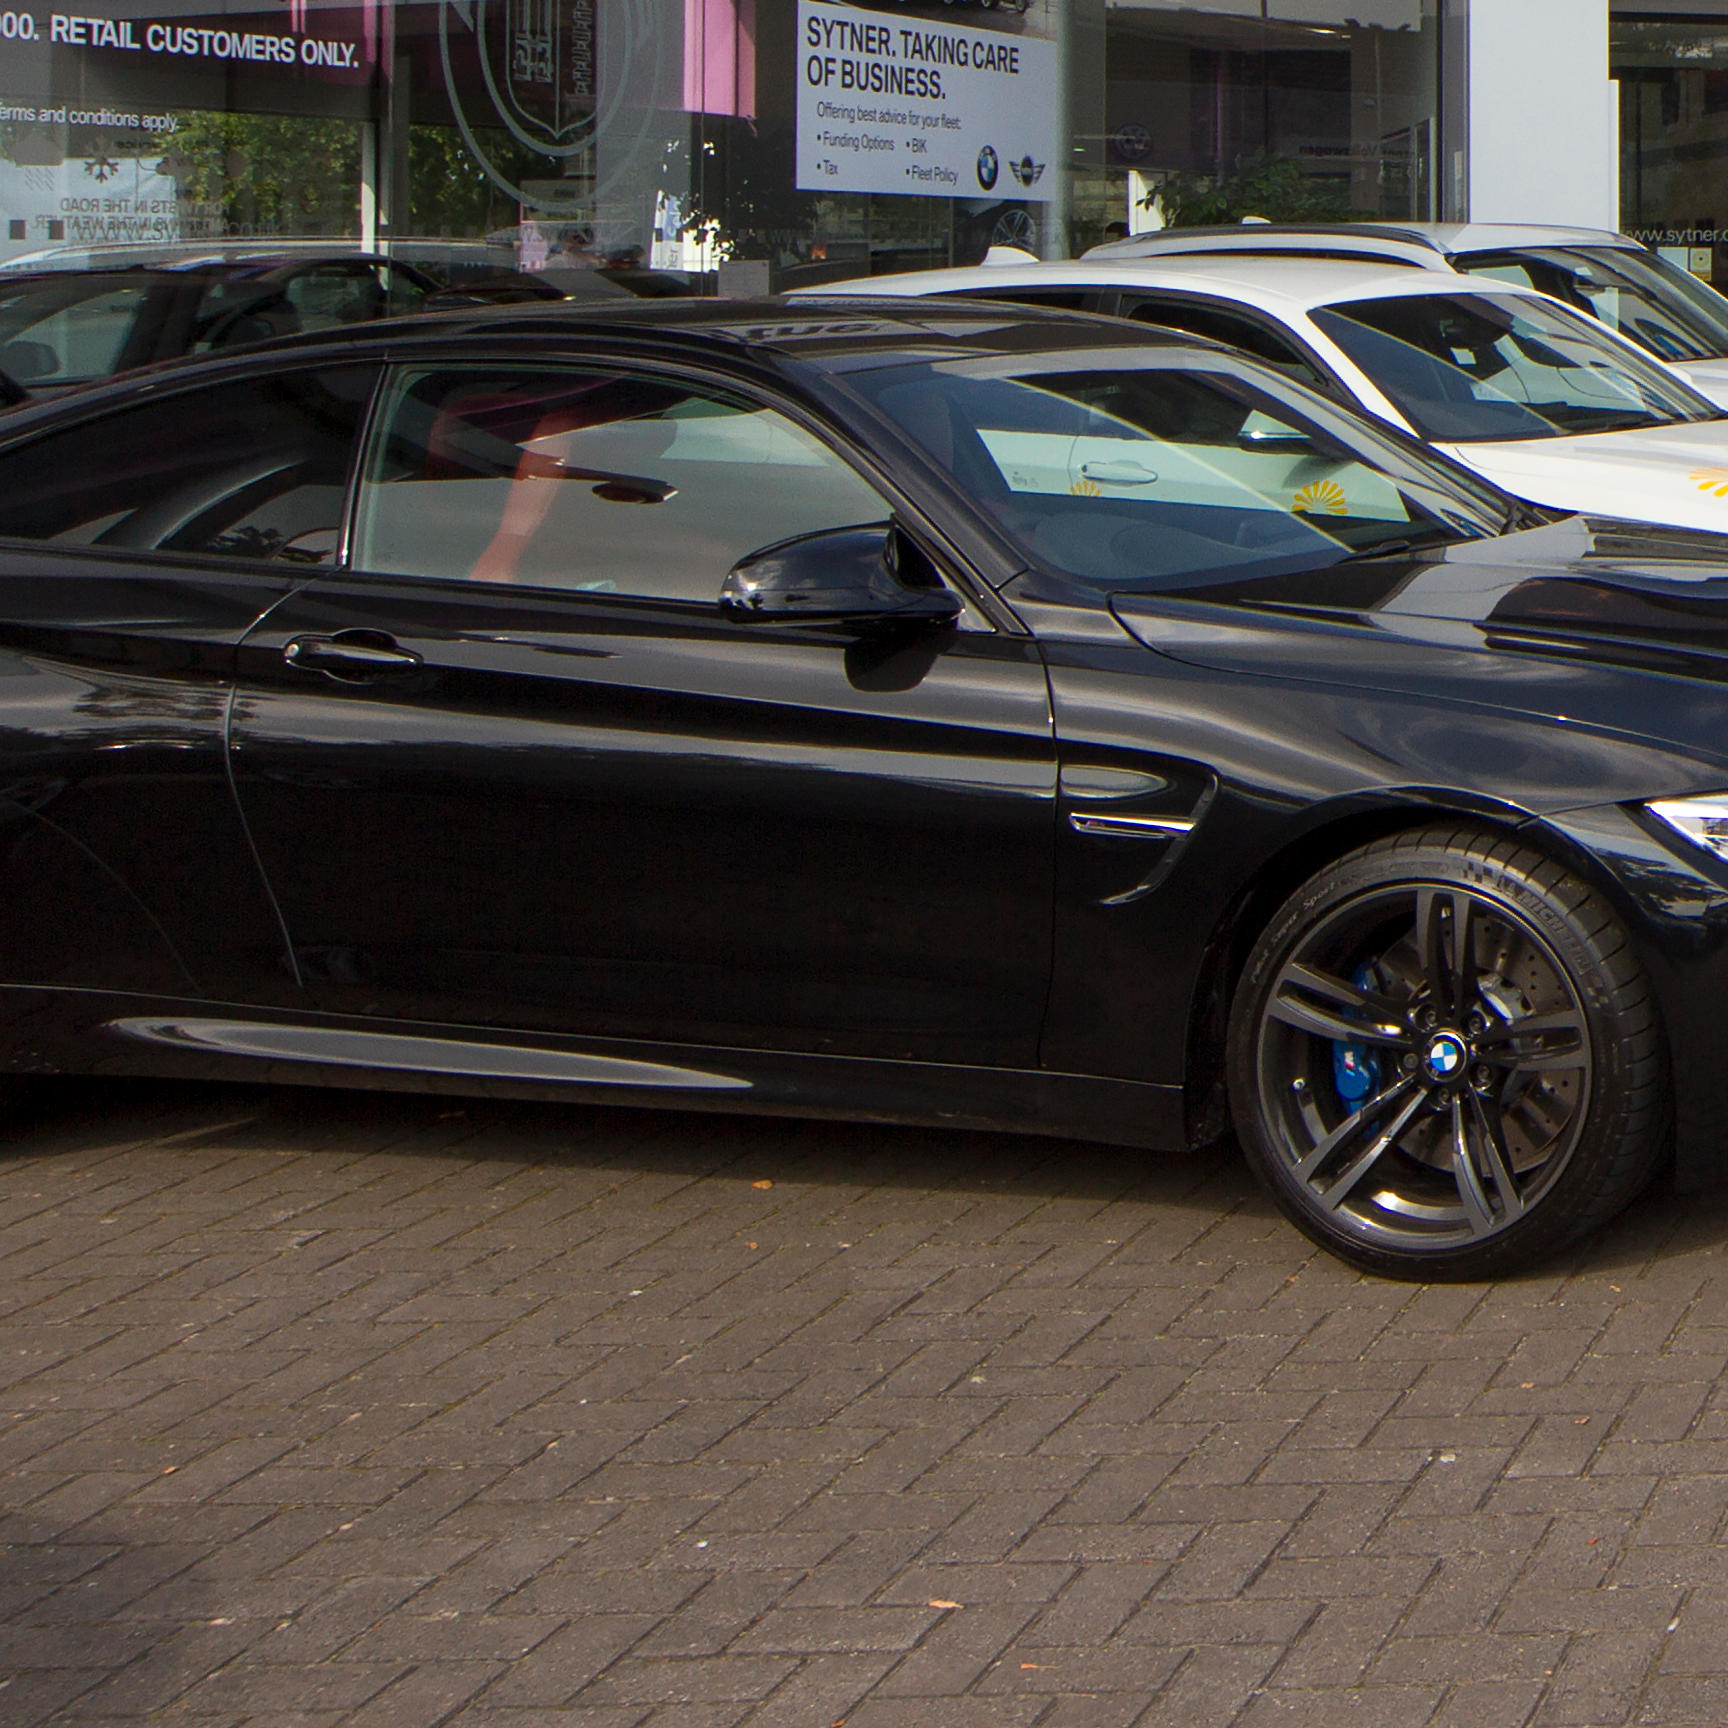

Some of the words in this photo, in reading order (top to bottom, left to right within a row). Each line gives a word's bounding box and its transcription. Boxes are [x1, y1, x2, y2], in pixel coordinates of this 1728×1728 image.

[0, 10, 40, 41] 00.
[51, 14, 141, 50] RETAIL
[146, 25, 296, 64] CUSTOMERS
[301, 39, 359, 69] ONLY.
[807, 16, 896, 57] SYTNER.
[899, 30, 968, 66] TAKING
[972, 41, 1019, 73] CARE
[807, 55, 836, 86] OF
[841, 60, 946, 99] BUSINESS.
[38, 106, 66, 123] and
[69, 107, 139, 128] conditions
[817, 101, 855, 124] Offering
[857, 105, 877, 122] best
[878, 108, 906, 124] advice
[908, 110, 920, 125] for
[921, 114, 940, 130] your
[823, 131, 859, 151] Funding
[862, 134, 895, 152] Options
[823, 160, 838, 176] Tax
[911, 166, 932, 181] Fleet
[934, 168, 959, 184] Policy
